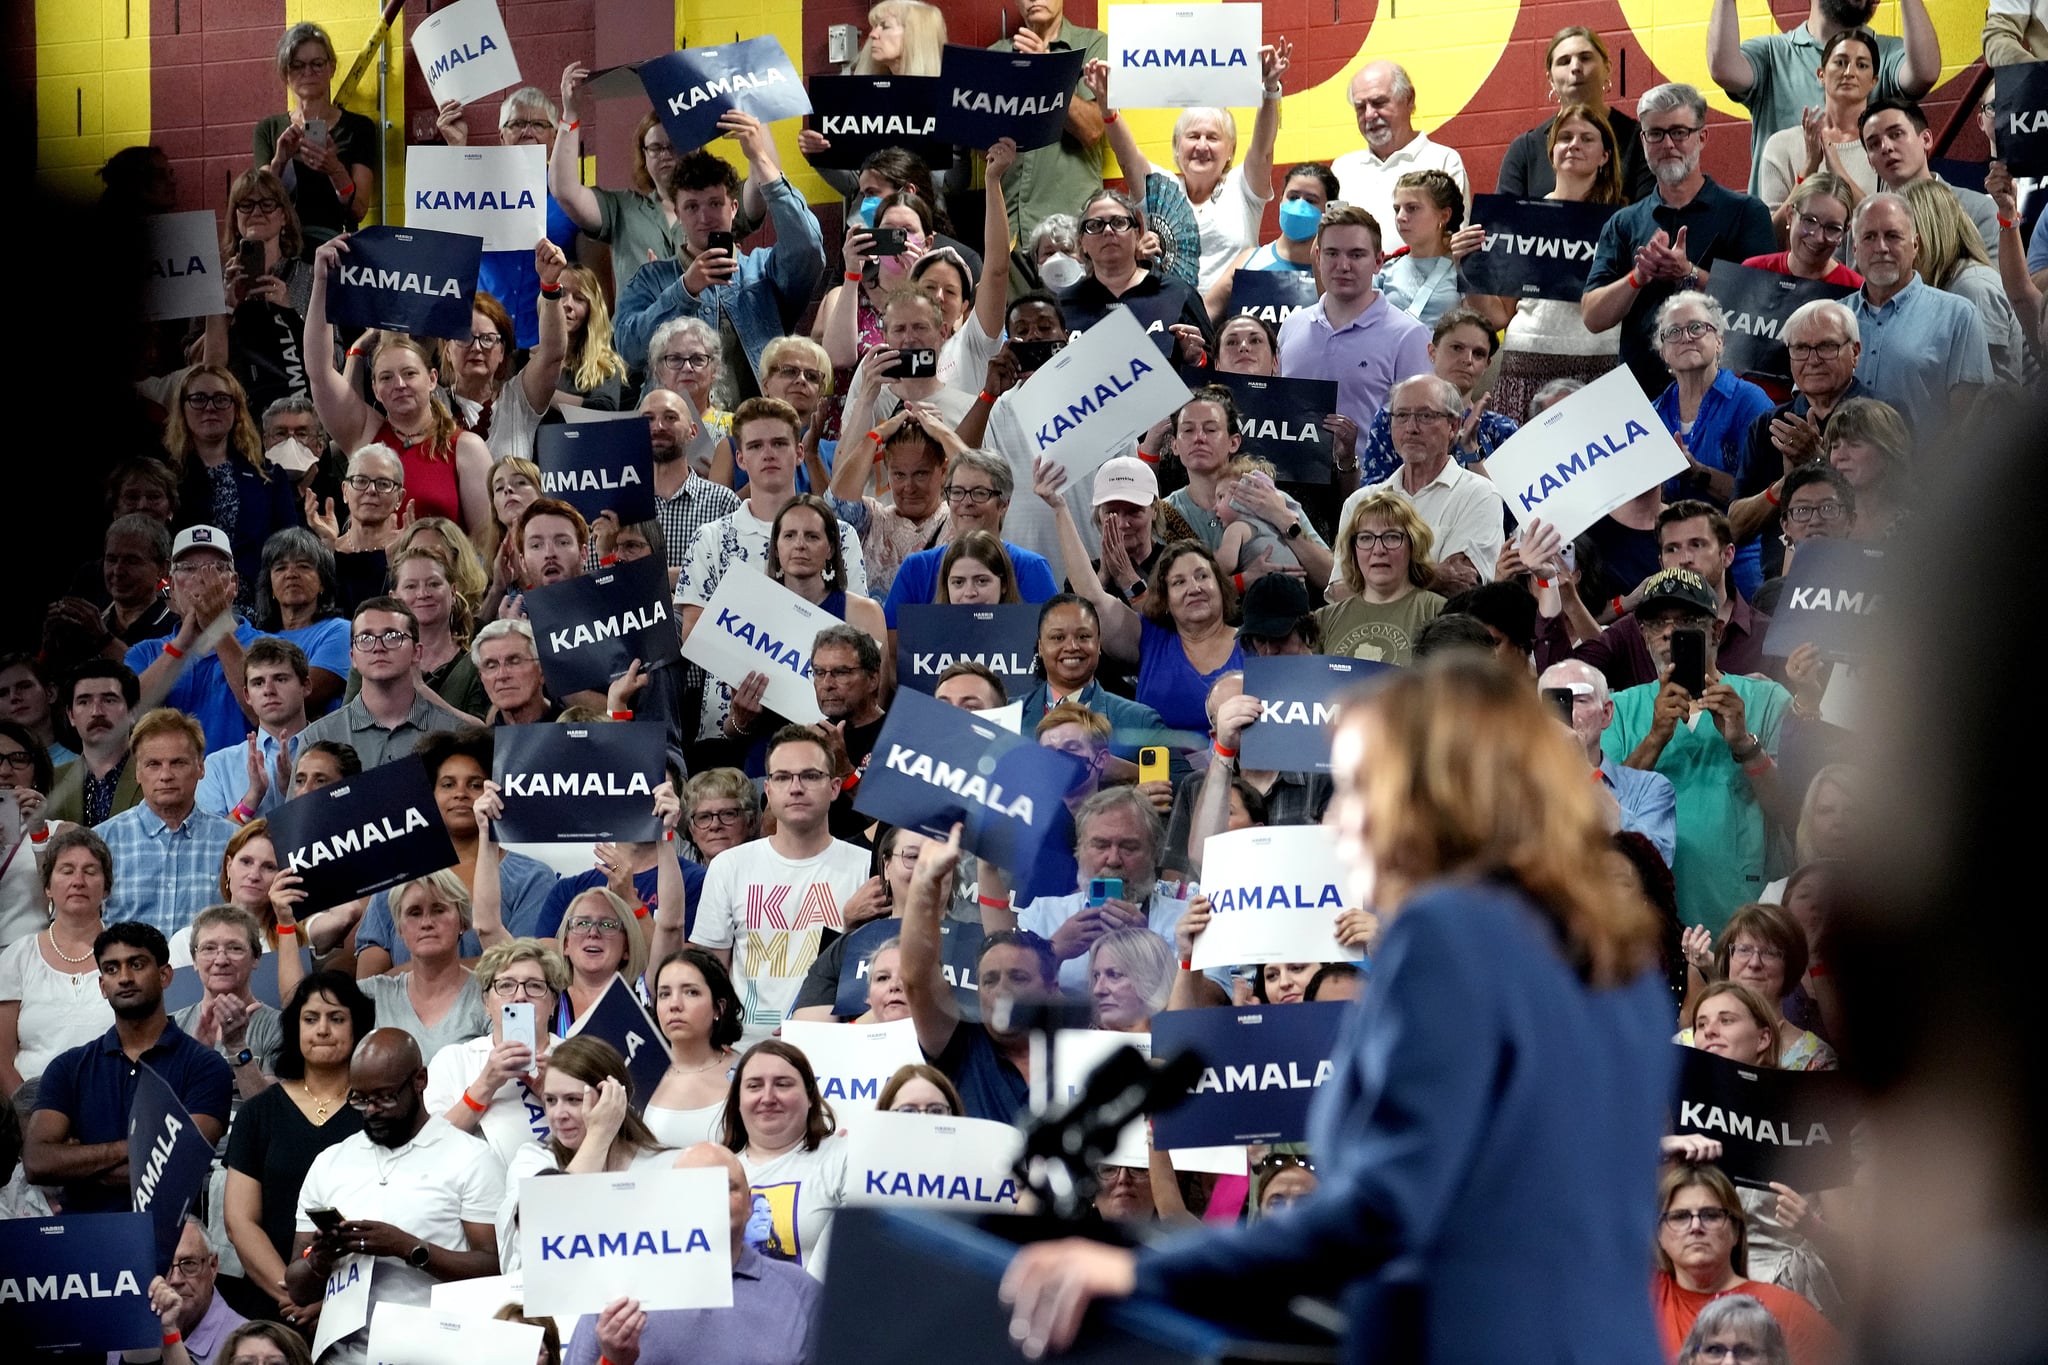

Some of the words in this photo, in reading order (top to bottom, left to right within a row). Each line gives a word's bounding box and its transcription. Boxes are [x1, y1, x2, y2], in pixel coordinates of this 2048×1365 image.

[427, 34, 498, 87] KAMALA
[1122, 48, 1247, 67] KAMALA
[667, 67, 787, 117] KAMALA
[952, 87, 1064, 116] KAMALA
[822, 115, 936, 135] KAMALA
[415, 190, 535, 210] KAMALA
[150, 256, 207, 279] ALA
[340, 265, 462, 299] KAMALA
[1241, 305, 1303, 323] KAM
[1718, 309, 1783, 340] KAM
[274, 313, 307, 400] AMALA
[1035, 357, 1154, 451] KAMALA
[1235, 418, 1320, 443] MALA
[1518, 419, 1650, 513] KAMALA
[549, 600, 667, 654] KAMALA
[716, 607, 815, 680] KAMA
[1336, 625, 1409, 654] WISCONSIN
[1260, 700, 1341, 725] KAM
[505, 771, 651, 797] KAMALA
[886, 743, 1034, 826] KAMALA
[287, 806, 430, 874] KAMALA
[746, 882, 843, 931] KA
[1208, 884, 1343, 914] KAMALA
[1187, 1060, 1336, 1094] AMALA
[1680, 1100, 1832, 1147] KAMALA
[133, 1113, 183, 1213] AMALA
[866, 1170, 1019, 1204] KAMALA
[541, 1227, 711, 1261] KAMALA
[0, 1270, 142, 1304] AMALA
[325, 1262, 360, 1303] ALA
